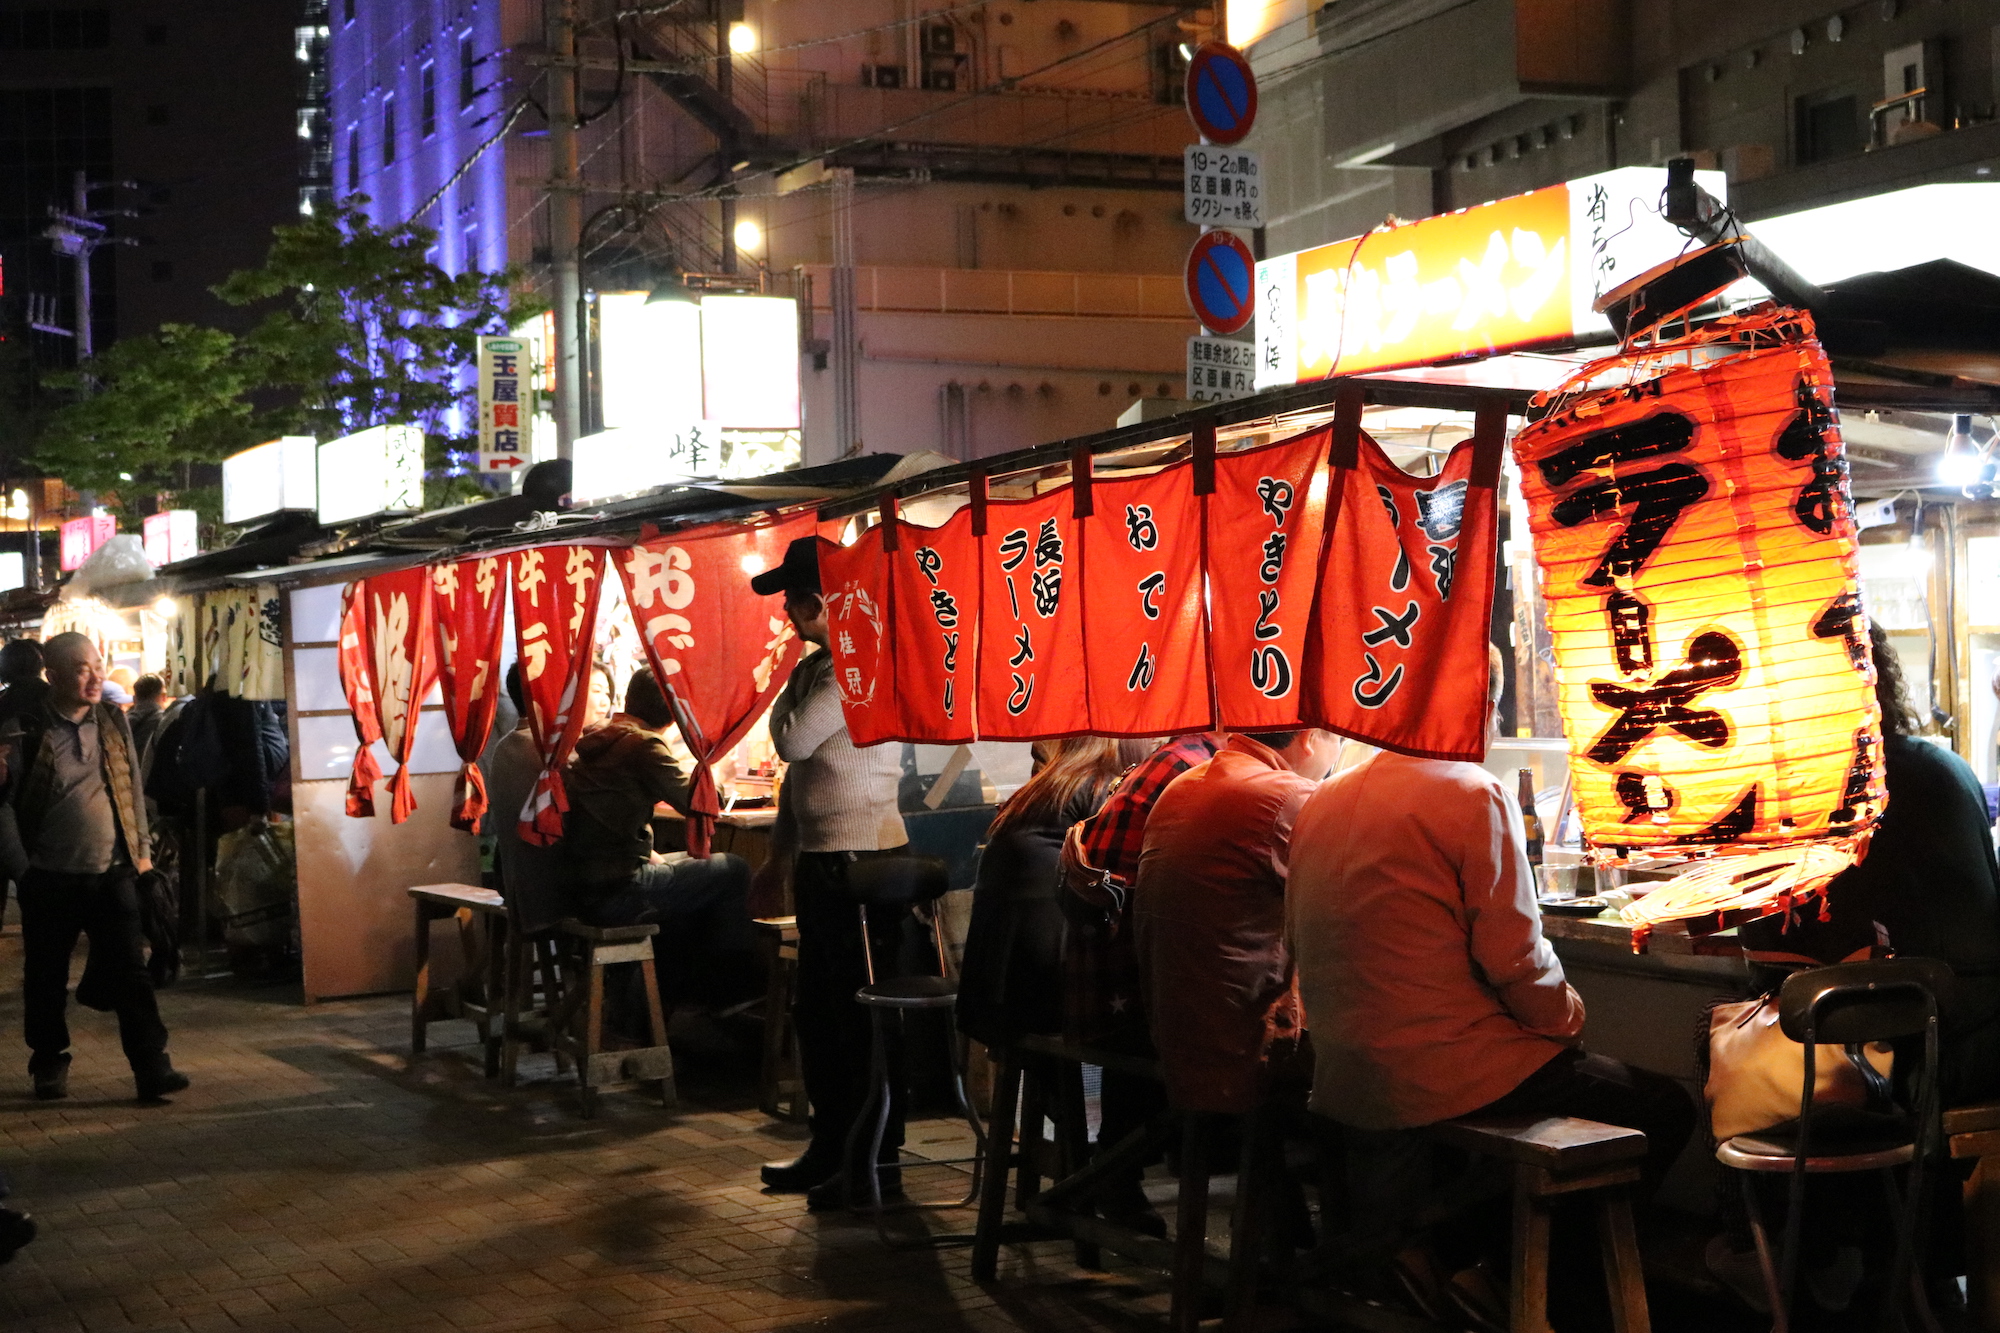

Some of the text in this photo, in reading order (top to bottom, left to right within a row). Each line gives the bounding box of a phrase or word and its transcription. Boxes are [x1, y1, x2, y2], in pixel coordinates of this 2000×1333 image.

[1191, 152, 1257, 176] 19-2の間の
[1191, 175, 1258, 198] 区画線内の
[1191, 198, 1259, 221] タクシーを除く
[492, 355, 518, 452] 玉屋質店
[669, 425, 710, 472] 峰
[915, 545, 960, 720] やきとり
[998, 528, 1035, 717] ラーメン
[1125, 503, 1166, 691] おでん
[1250, 475, 1294, 700] やきとり
[838, 592, 862, 696] 月桂冠
